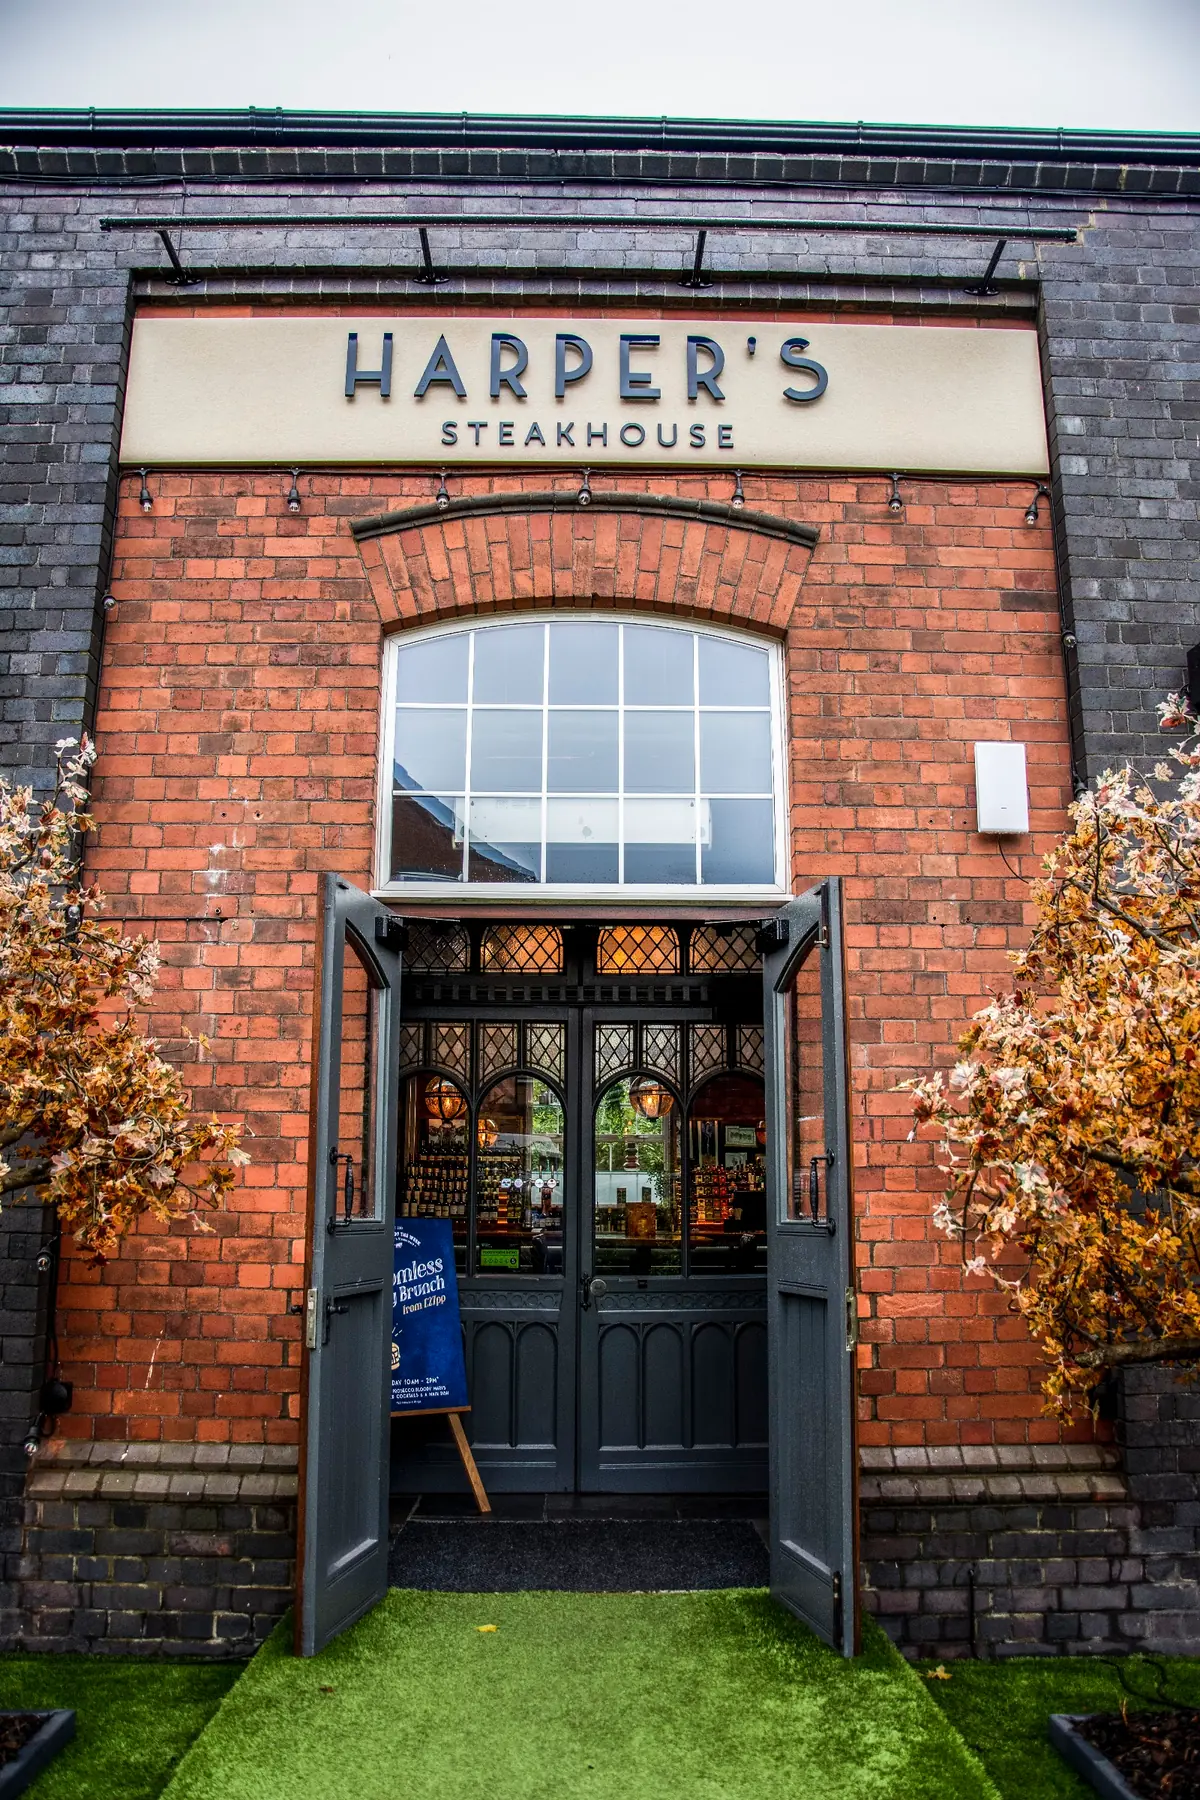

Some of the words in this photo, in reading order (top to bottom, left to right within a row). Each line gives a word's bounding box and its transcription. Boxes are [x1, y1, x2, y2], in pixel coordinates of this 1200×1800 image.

[344, 332, 829, 402] HARPER'S
[441, 421, 735, 448] STEAKHOUSE
[399, 1274, 446, 1302] Brunch
[402, 1302, 423, 1315] from
